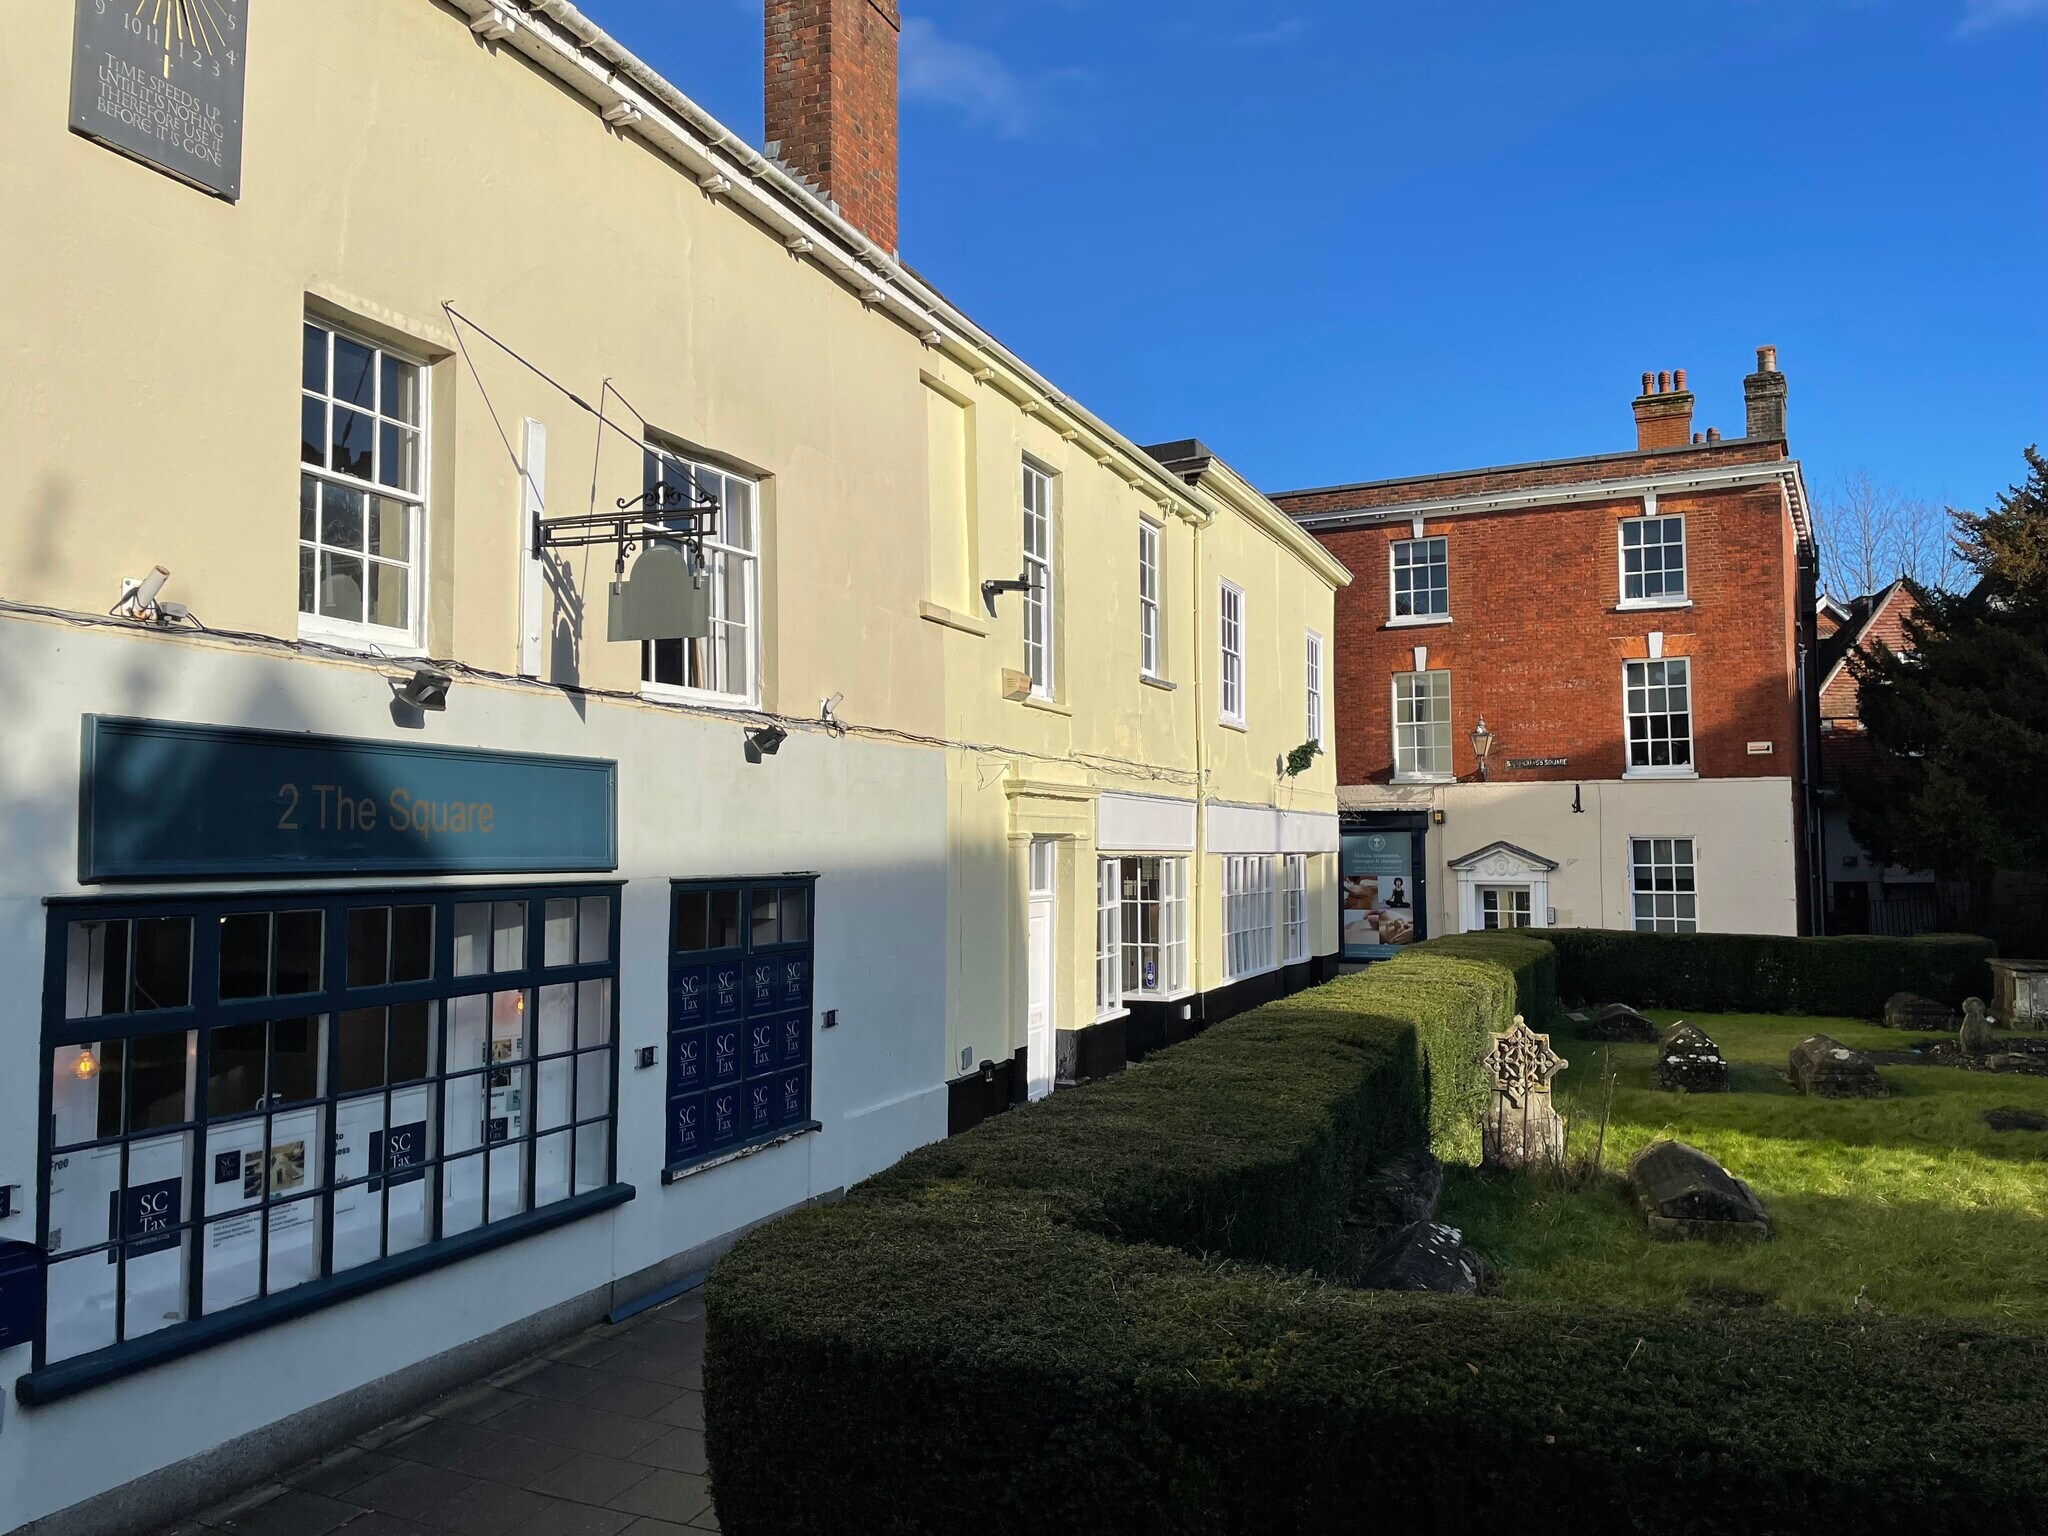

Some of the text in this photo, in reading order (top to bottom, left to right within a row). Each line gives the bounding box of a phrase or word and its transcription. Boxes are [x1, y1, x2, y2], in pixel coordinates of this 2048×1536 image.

[123, 12, 142, 35] 10
[227, 15, 237, 31] 5
[146, 25, 159, 46] 11
[178, 41, 185, 58] 1
[192, 49, 203, 68] 2
[225, 49, 237, 66] 4
[211, 59, 221, 77] 3
[105, 51, 221, 121] TIME SPEEDS UP
[99, 65, 138, 97] UNTIL
[154, 92, 166, 109] IS
[167, 99, 224, 139] NOTHING
[98, 80, 223, 152] THEREFORE USE IT
[97, 95, 222, 167] BEFORE IT IS GONE
[1544, 758, 1568, 766] SQUARE
[277, 782, 495, 839] 2 The Square
[755, 965, 770, 983] SC
[787, 961, 801, 978] SC
[681, 975, 699, 994] SC
[718, 970, 734, 989] SC
[787, 980, 801, 993] Tax
[718, 990, 734, 1006] Tax
[755, 985, 769, 998] Tax
[682, 996, 698, 1011] Tax
[753, 1025, 770, 1047] SC
[786, 1019, 800, 1037] SC
[680, 1040, 698, 1060] SC
[716, 1033, 735, 1056] SC
[785, 1038, 799, 1052] Tax
[716, 1057, 734, 1074] Tax
[753, 1049, 769, 1065] Tax
[680, 1062, 697, 1077] Tax
[784, 1077, 799, 1095] SC
[753, 1086, 768, 1105] SC
[784, 1097, 798, 1110] Tax
[716, 1095, 732, 1116] SC
[753, 1106, 768, 1120] Tax
[678, 1105, 696, 1126] SC
[716, 1117, 732, 1132] Tax
[390, 1133, 411, 1153] SC
[678, 1127, 696, 1143] Tax
[389, 1154, 410, 1169] Tax
[139, 1190, 169, 1216] SC
[139, 1216, 167, 1233] Tax
